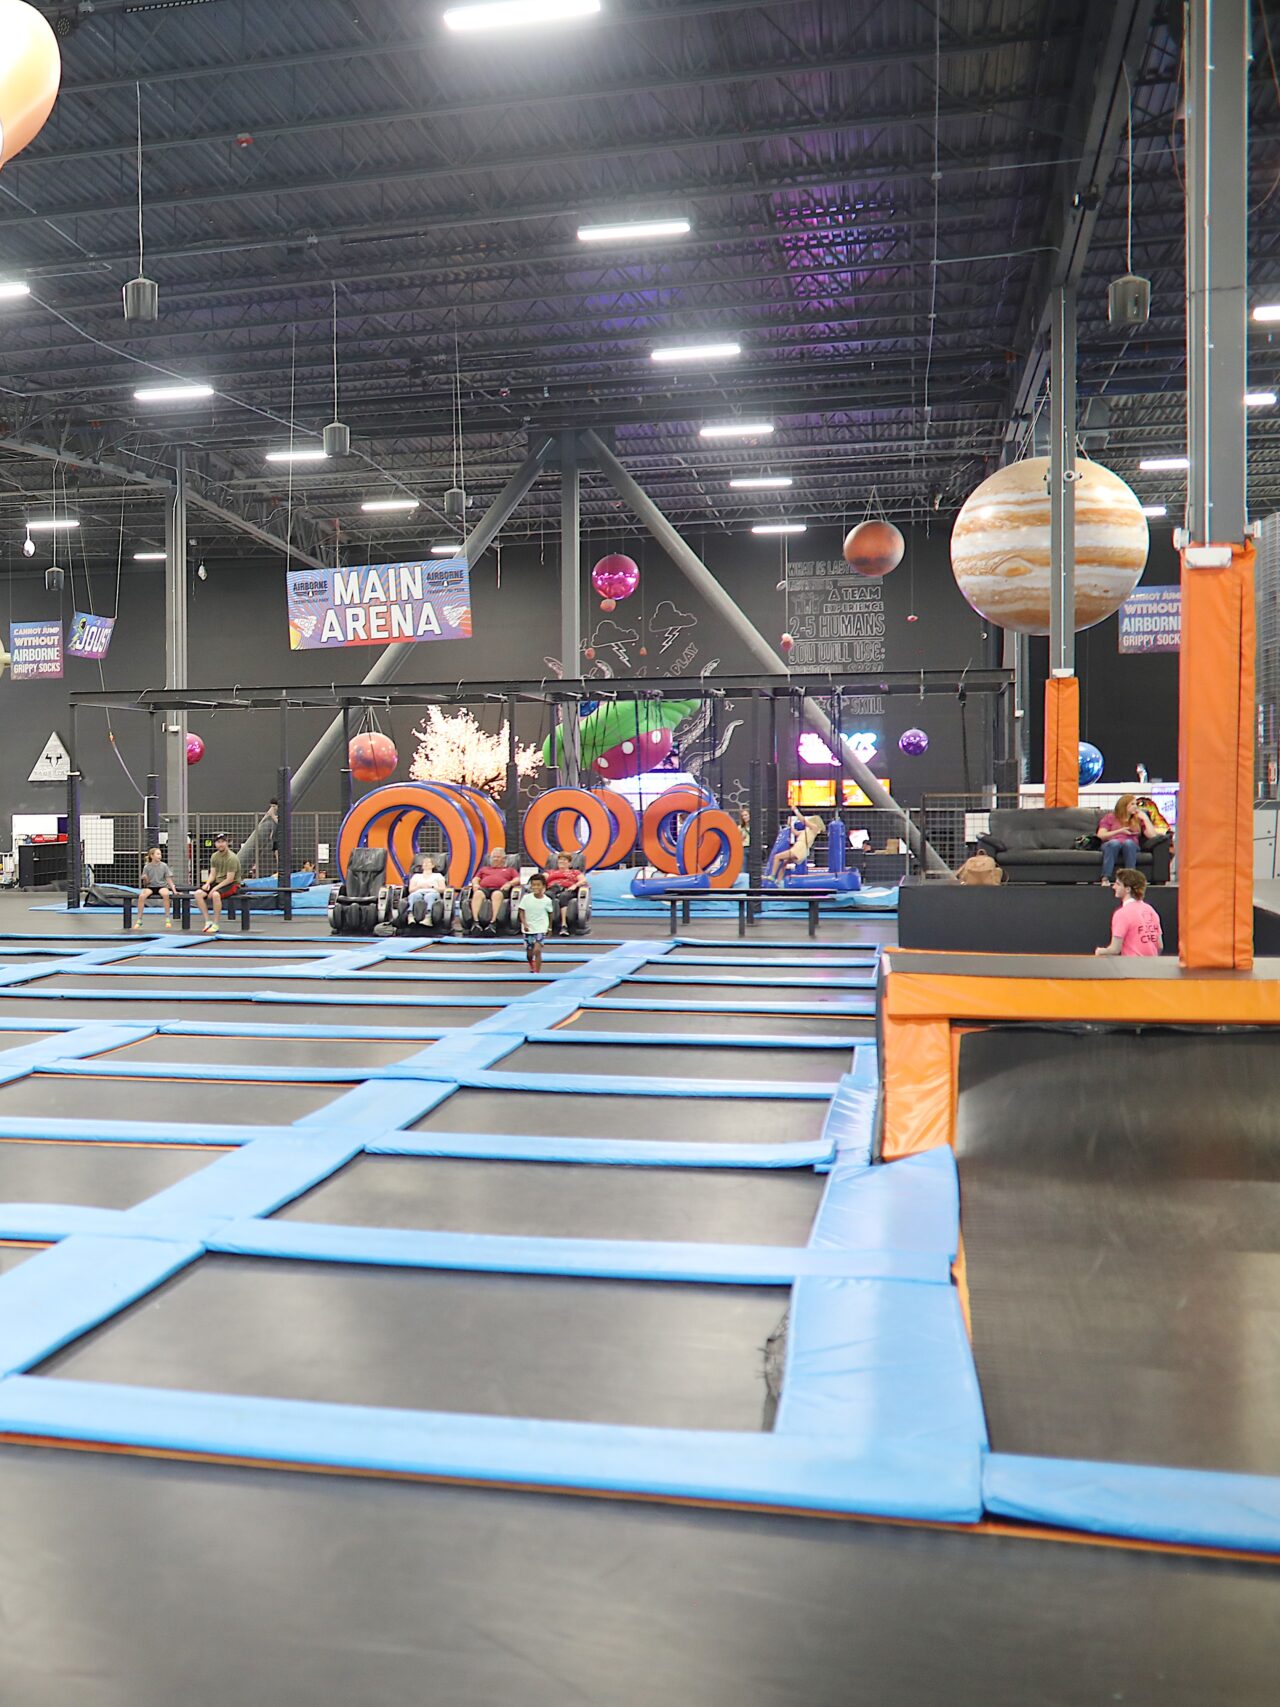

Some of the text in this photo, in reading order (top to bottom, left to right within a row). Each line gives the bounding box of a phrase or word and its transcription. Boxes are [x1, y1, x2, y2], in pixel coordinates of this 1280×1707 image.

[426, 570, 464, 581] AIRBORNE
[293, 581, 328, 591] AIRBORNE
[333, 566, 424, 606] MAIN
[828, 586, 880, 601] A TEAM
[824, 602, 884, 613] EXPERIENCE
[320, 602, 442, 643] ARENA
[790, 613, 885, 638] 2-5 HUMANS
[1122, 616, 1181, 632] AIRBORN
[13, 626, 60, 636] CANNOT JUMP
[14, 635, 60, 646] WITHOUT
[76, 625, 112, 653] JOUST
[1123, 635, 1155, 646] GRIPPY
[13, 647, 61, 662] AIRBORNE
[671, 642, 699, 675] PLAY
[818, 643, 851, 664] WILL
[853, 641, 886, 662] USE:
[13, 662, 61, 673] GRIPPY SOCKS
[851, 697, 885, 714] SKILL
